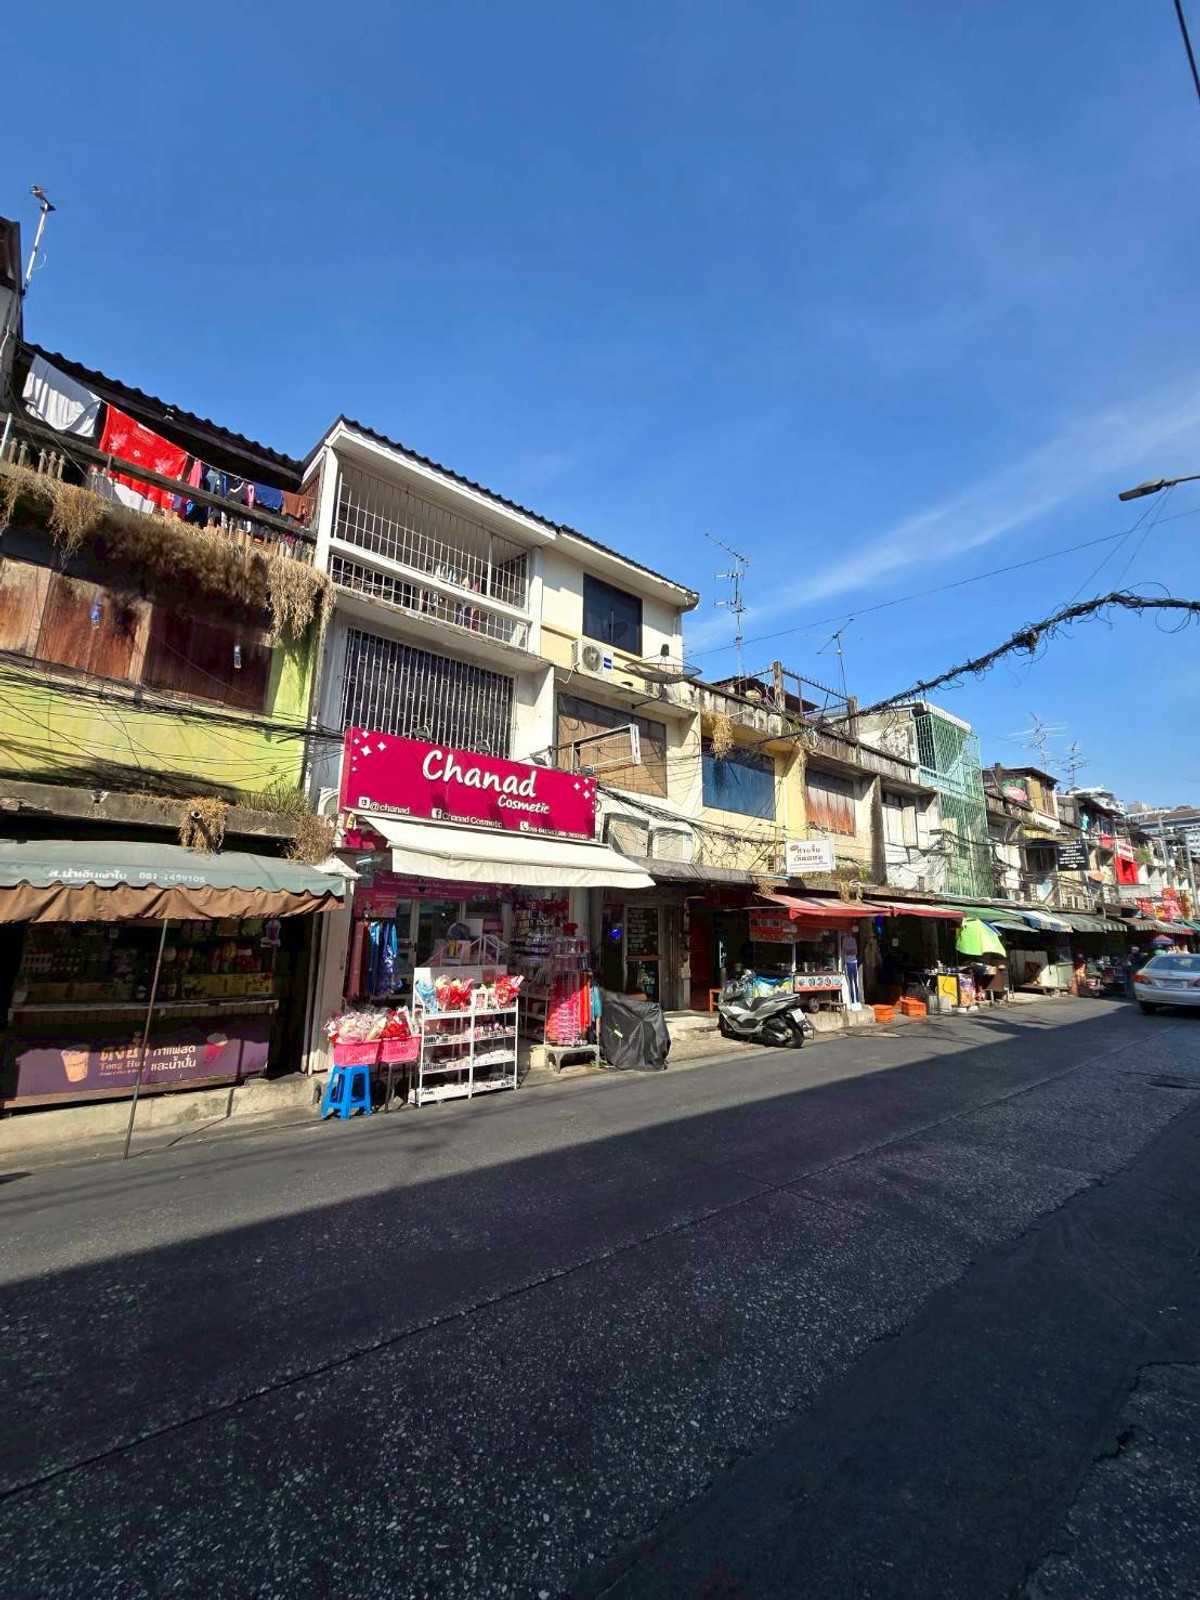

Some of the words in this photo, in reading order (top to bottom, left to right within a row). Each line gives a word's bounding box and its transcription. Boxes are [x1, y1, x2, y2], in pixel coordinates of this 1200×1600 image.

[423, 750, 537, 798] Chanad
[370, 801, 410, 815] @chanad
[498, 794, 550, 814] Cosmetic
